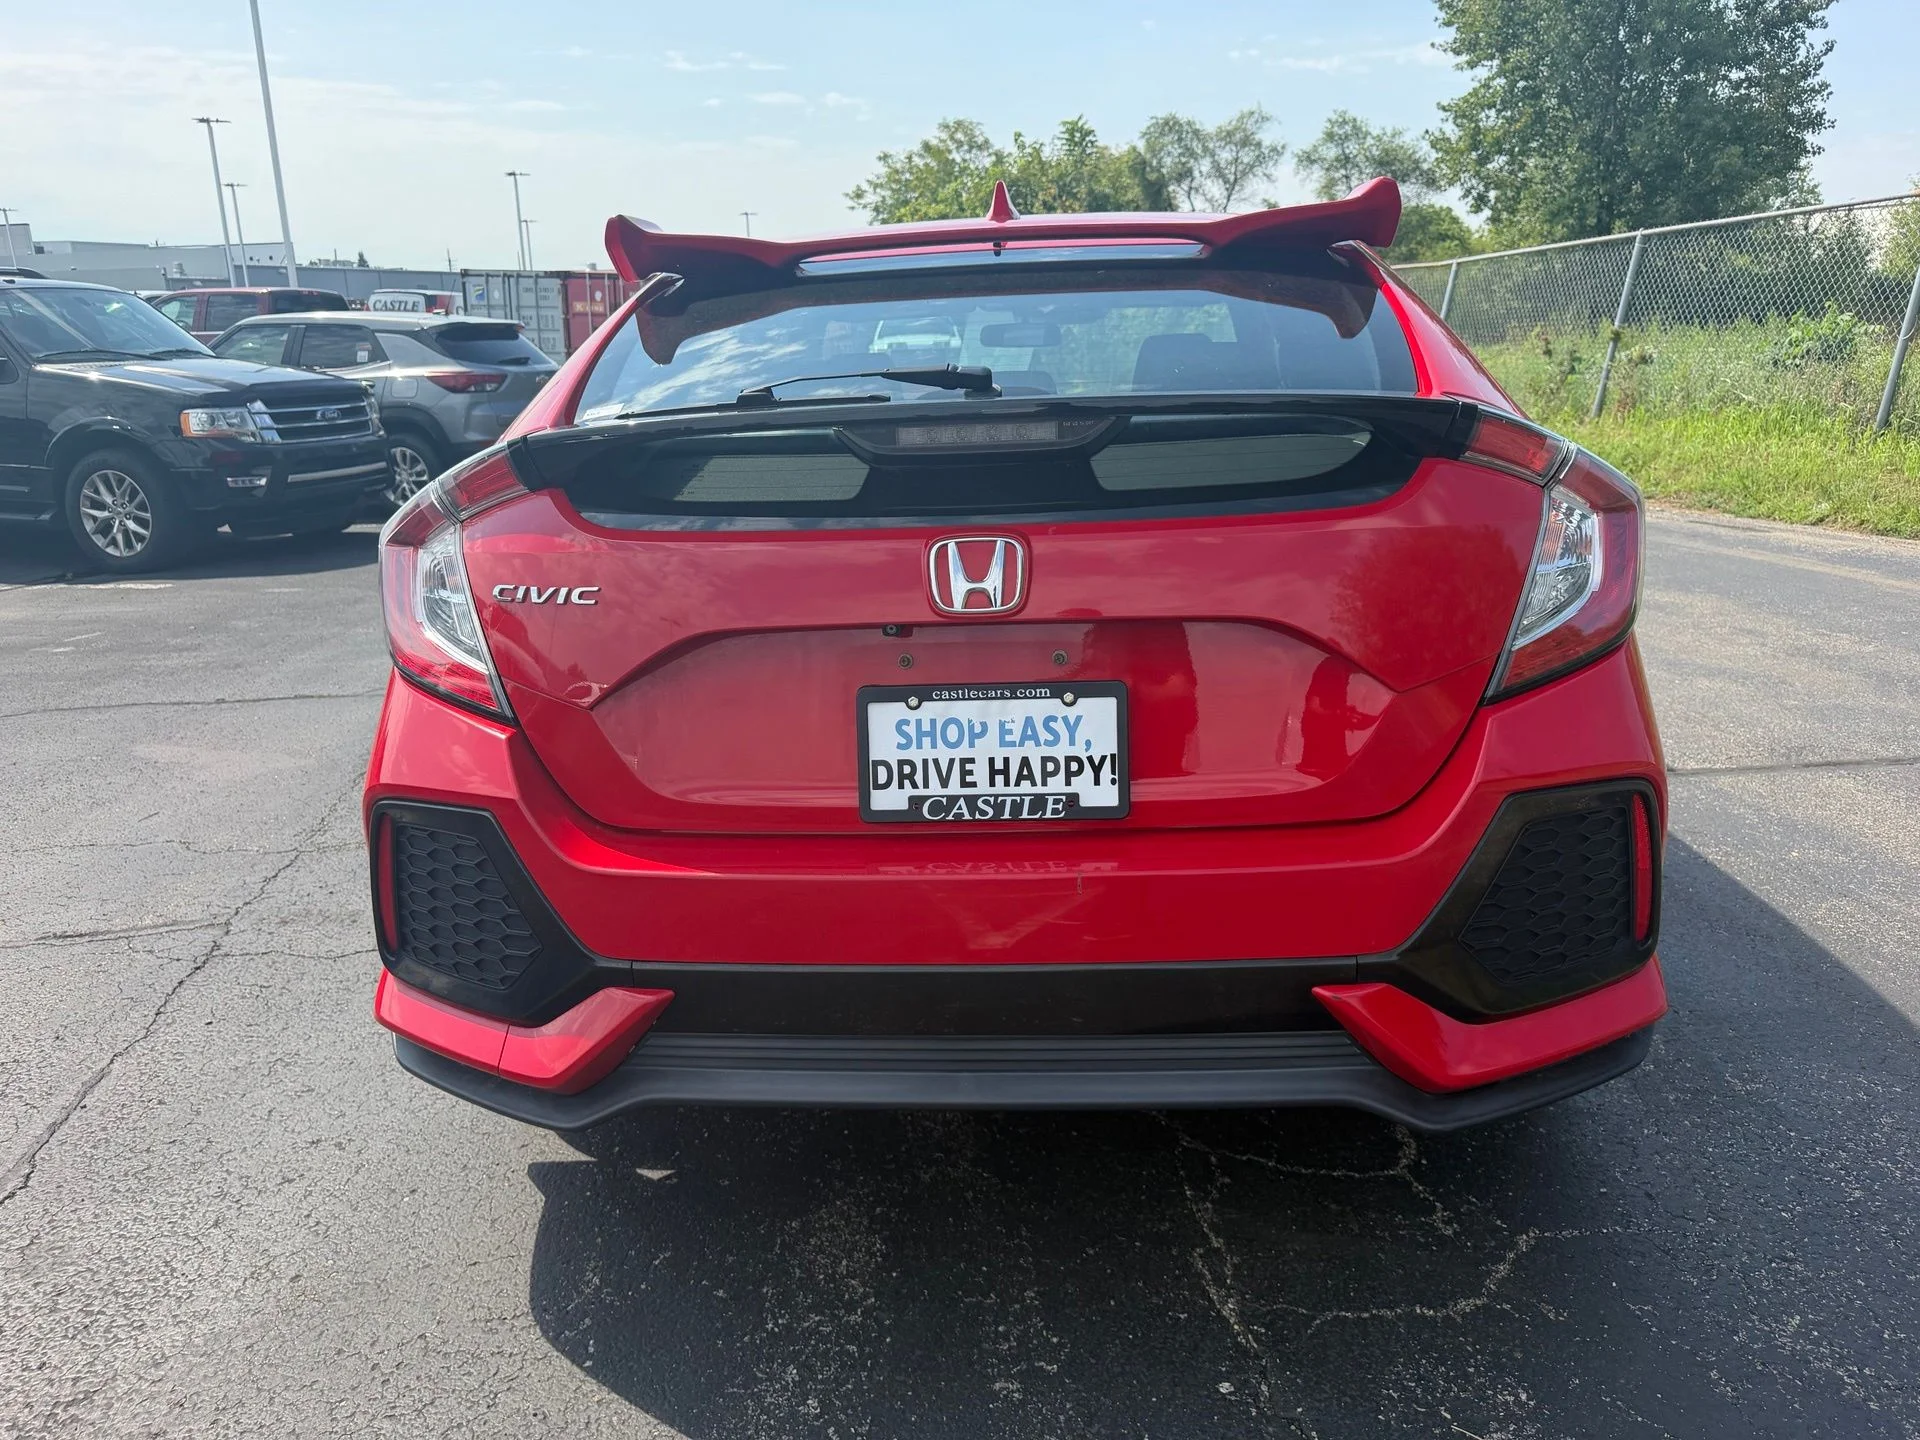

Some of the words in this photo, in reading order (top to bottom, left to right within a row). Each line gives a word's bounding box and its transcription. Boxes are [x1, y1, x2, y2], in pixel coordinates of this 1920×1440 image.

[372, 299, 420, 312] CASTLE
[492, 584, 601, 605] CIVIC
[932, 687, 1051, 700] castlecars.com
[895, 717, 989, 750] SHOP
[998, 714, 1093, 752] EASY,
[871, 756, 978, 790] DRIVE
[988, 752, 1118, 788] HAPPY!
[921, 794, 1067, 820] CASTLE
